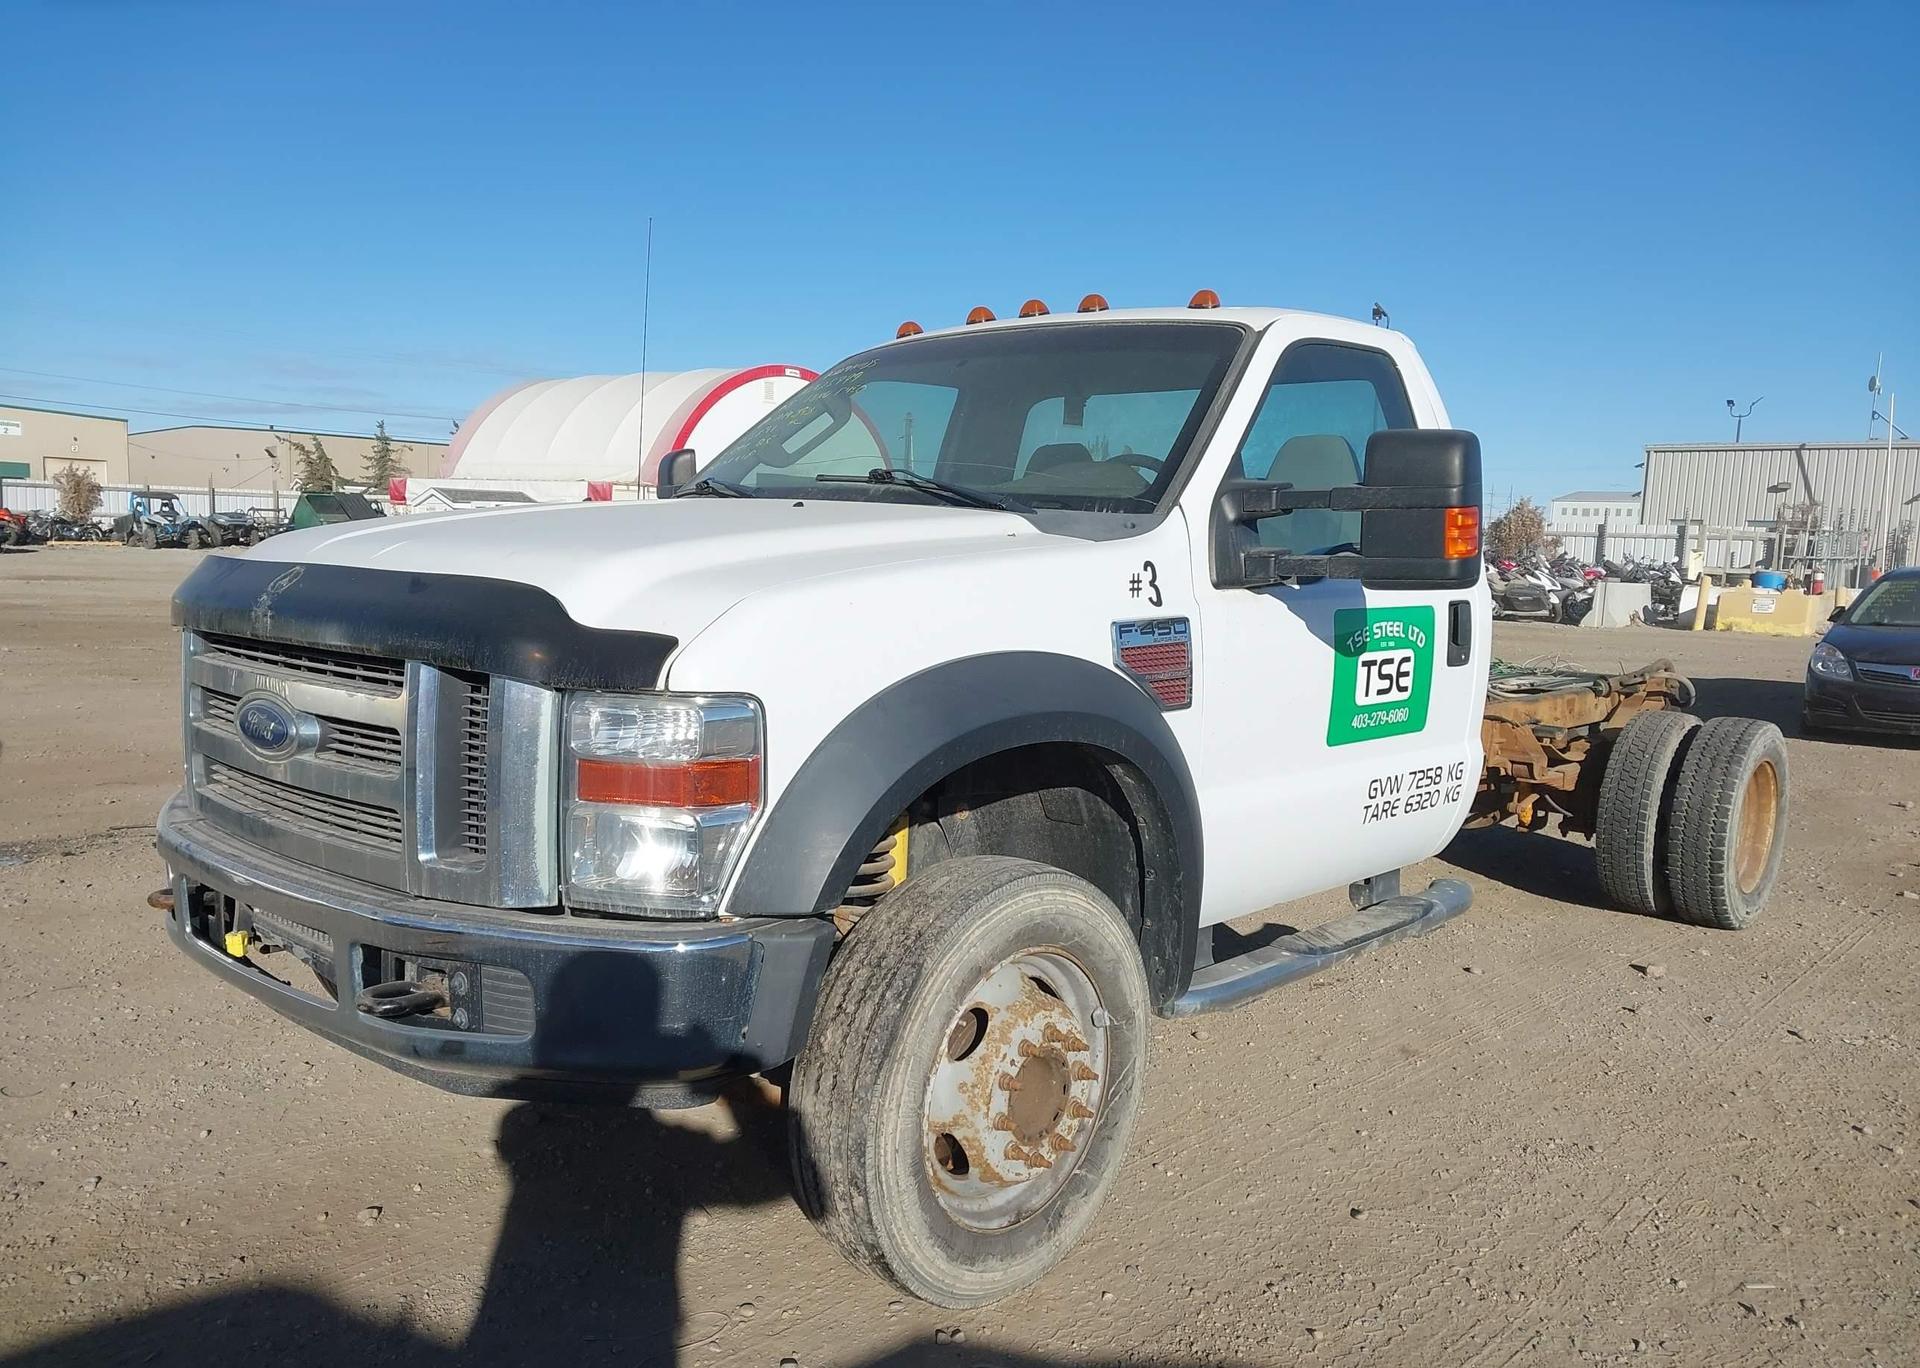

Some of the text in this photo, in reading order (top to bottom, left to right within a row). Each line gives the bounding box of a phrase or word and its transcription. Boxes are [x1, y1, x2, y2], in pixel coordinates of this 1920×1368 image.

[1129, 560, 1162, 607] #3
[1346, 621, 1426, 653] TSE STEEL LTD
[1362, 656, 1411, 697] TSE
[244, 709, 275, 741] Ford
[1368, 761, 1464, 800] GVW 7258 KG
[1362, 784, 1462, 824] TARE 6320 KG
